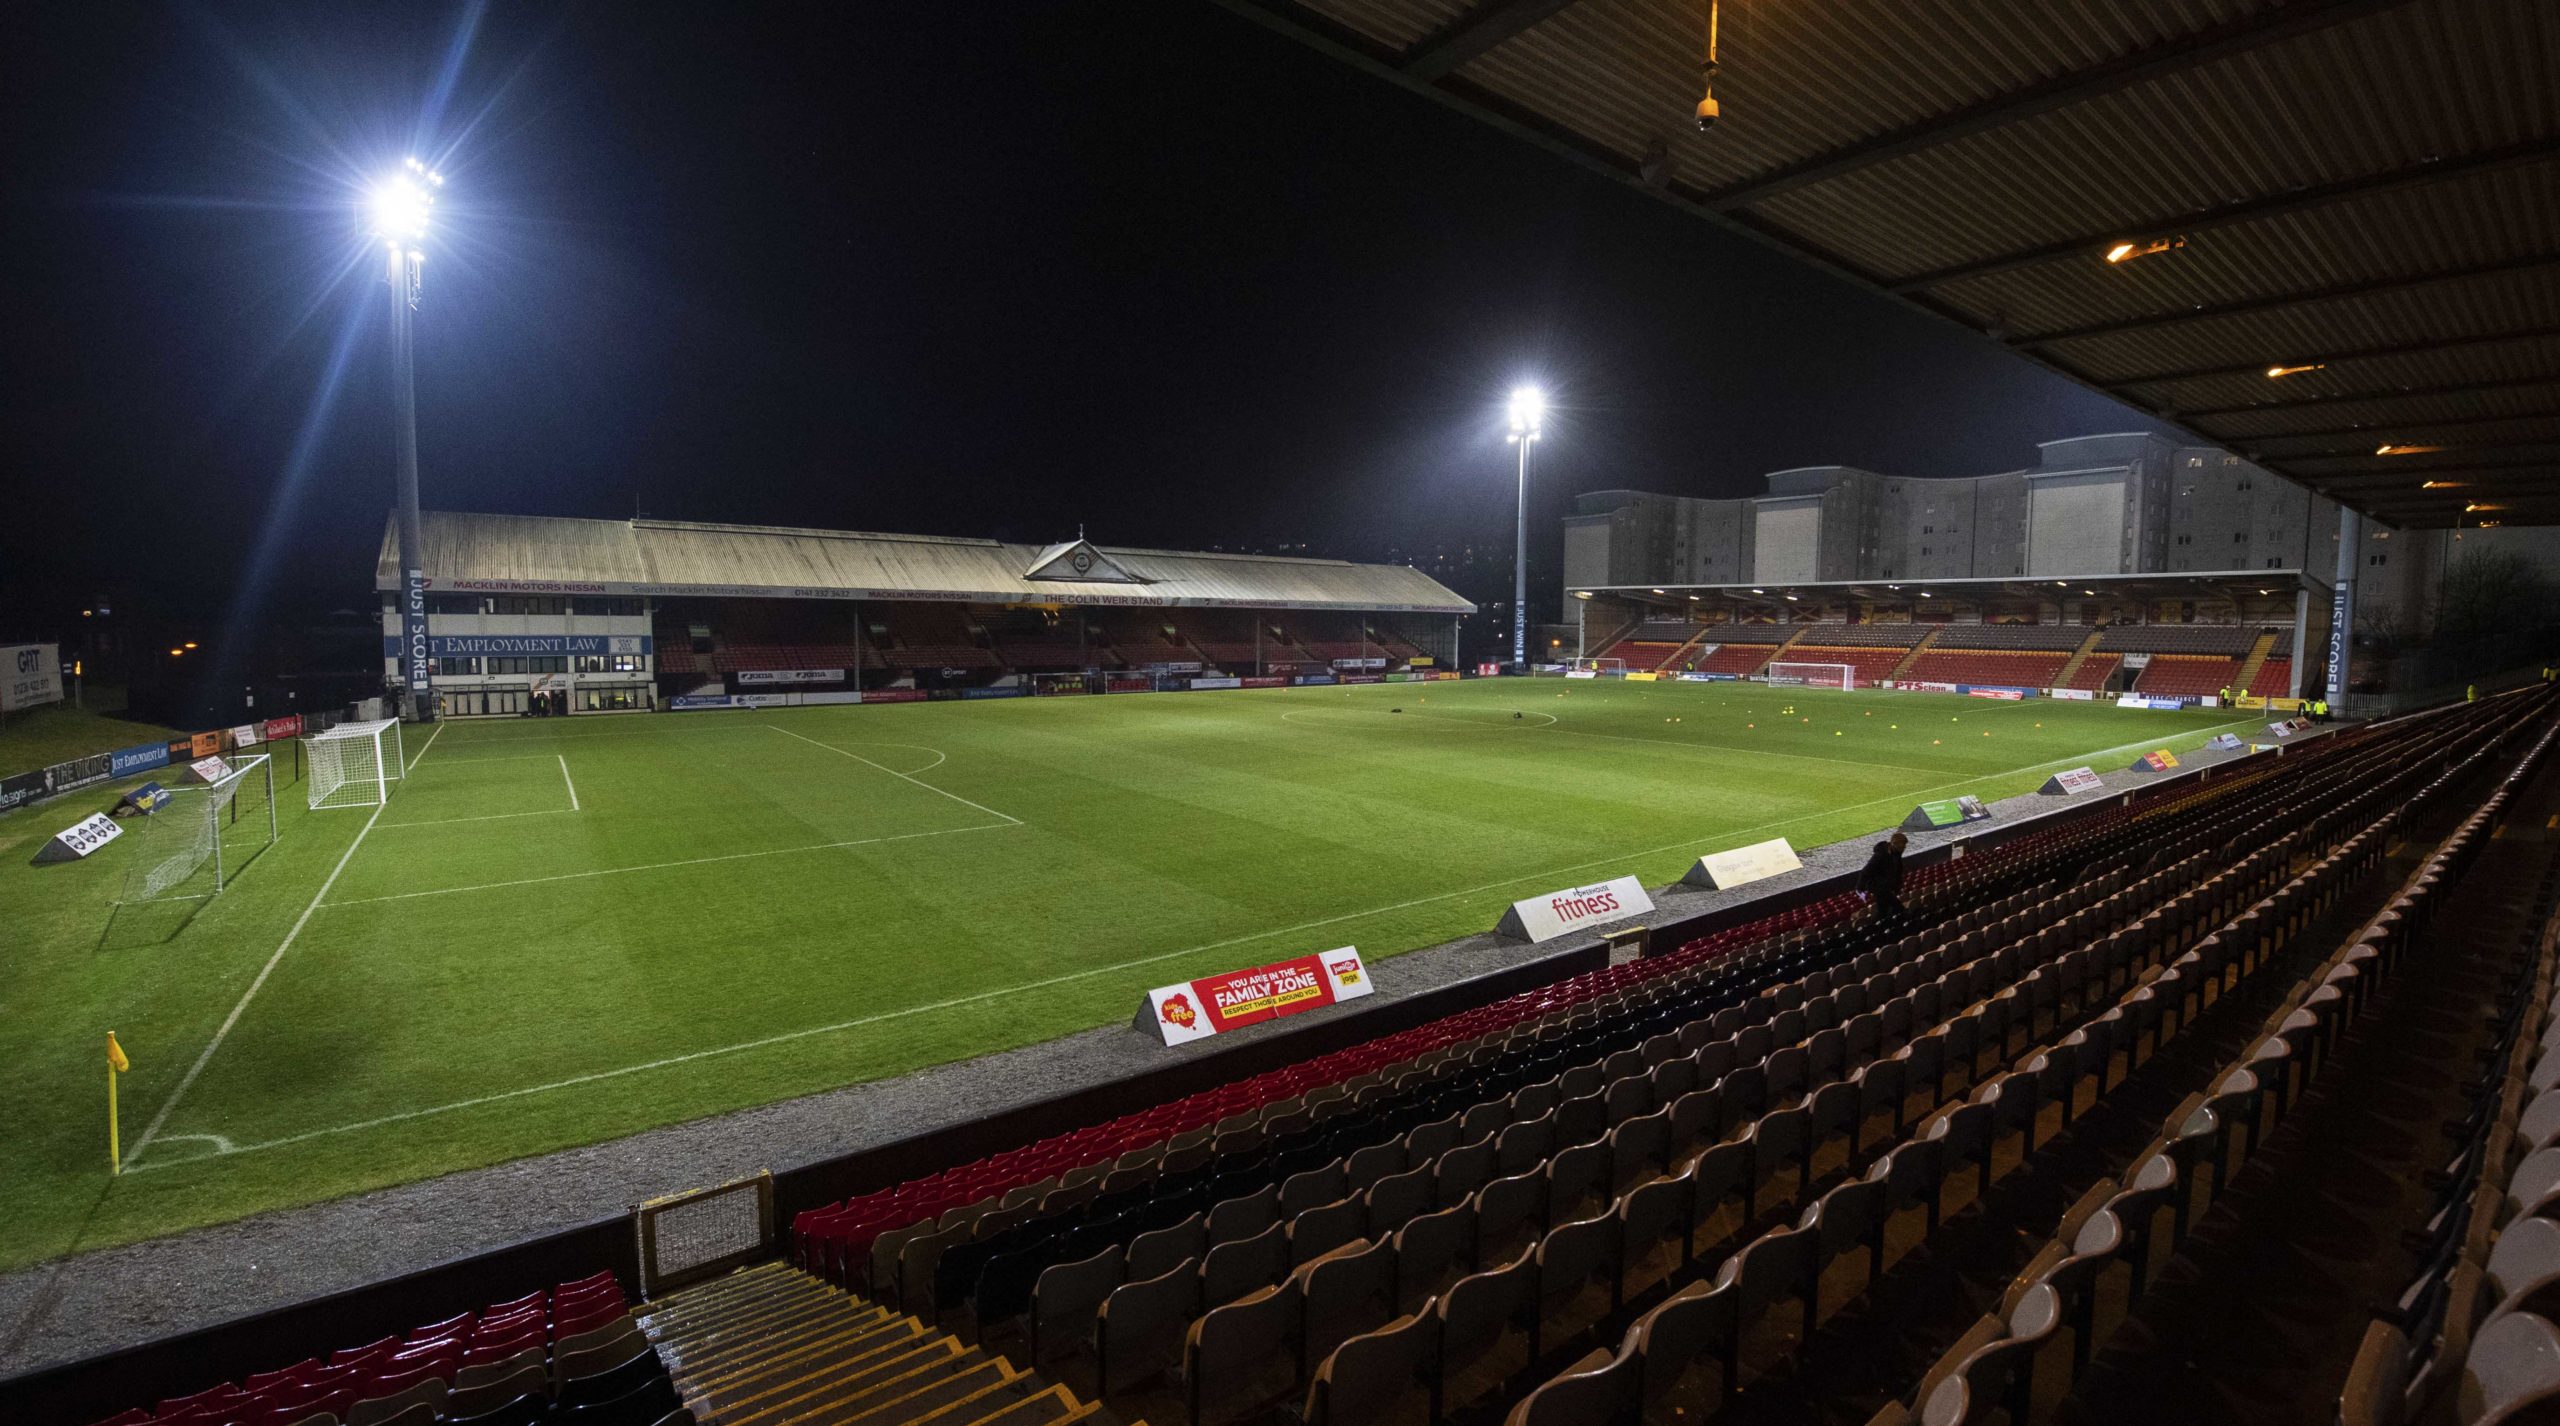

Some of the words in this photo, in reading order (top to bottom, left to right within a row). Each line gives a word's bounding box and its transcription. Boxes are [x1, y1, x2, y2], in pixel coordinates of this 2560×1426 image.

[453, 581, 508, 590] MACKLIN
[511, 583, 561, 591] MOTORS
[564, 584, 606, 592] NISSAN
[668, 585, 705, 594] Macklin
[868, 591, 905, 599] MACKLIN
[907, 592, 942, 600] MOTORS
[411, 580, 424, 619] JUST
[1043, 594, 1065, 603] THE
[1068, 595, 1100, 604] COLIN
[1101, 596, 1130, 605] WEIR
[1131, 597, 1163, 606] STAND
[1516, 608, 1524, 628] JUST
[1516, 630, 1524, 648] WIN
[18, 649, 40, 673] GRT
[412, 625, 427, 679] SCORE
[2328, 632, 2341, 682] SCORE
[57, 763, 74, 785] THE
[75, 756, 110, 778] VIKING
[1552, 893, 1619, 922] fitness
[1333, 962, 1356, 974] junior
[1227, 977, 1248, 990] YOU
[1250, 974, 1268, 985] ARE
[1269, 972, 1279, 981] IN
[1279, 968, 1297, 979] THE
[1341, 974, 1358, 984] jogs
[1215, 983, 1271, 1007] FAMILY
[1275, 973, 1318, 993] ZONE
[1164, 1003, 1178, 1011] kids
[1224, 1002, 1253, 1016] RESPECT
[1254, 997, 1277, 1009] THOSE
[1278, 992, 1304, 1004] AROUND
[1303, 988, 1318, 998] YOU
[1171, 1010, 1195, 1022] free
